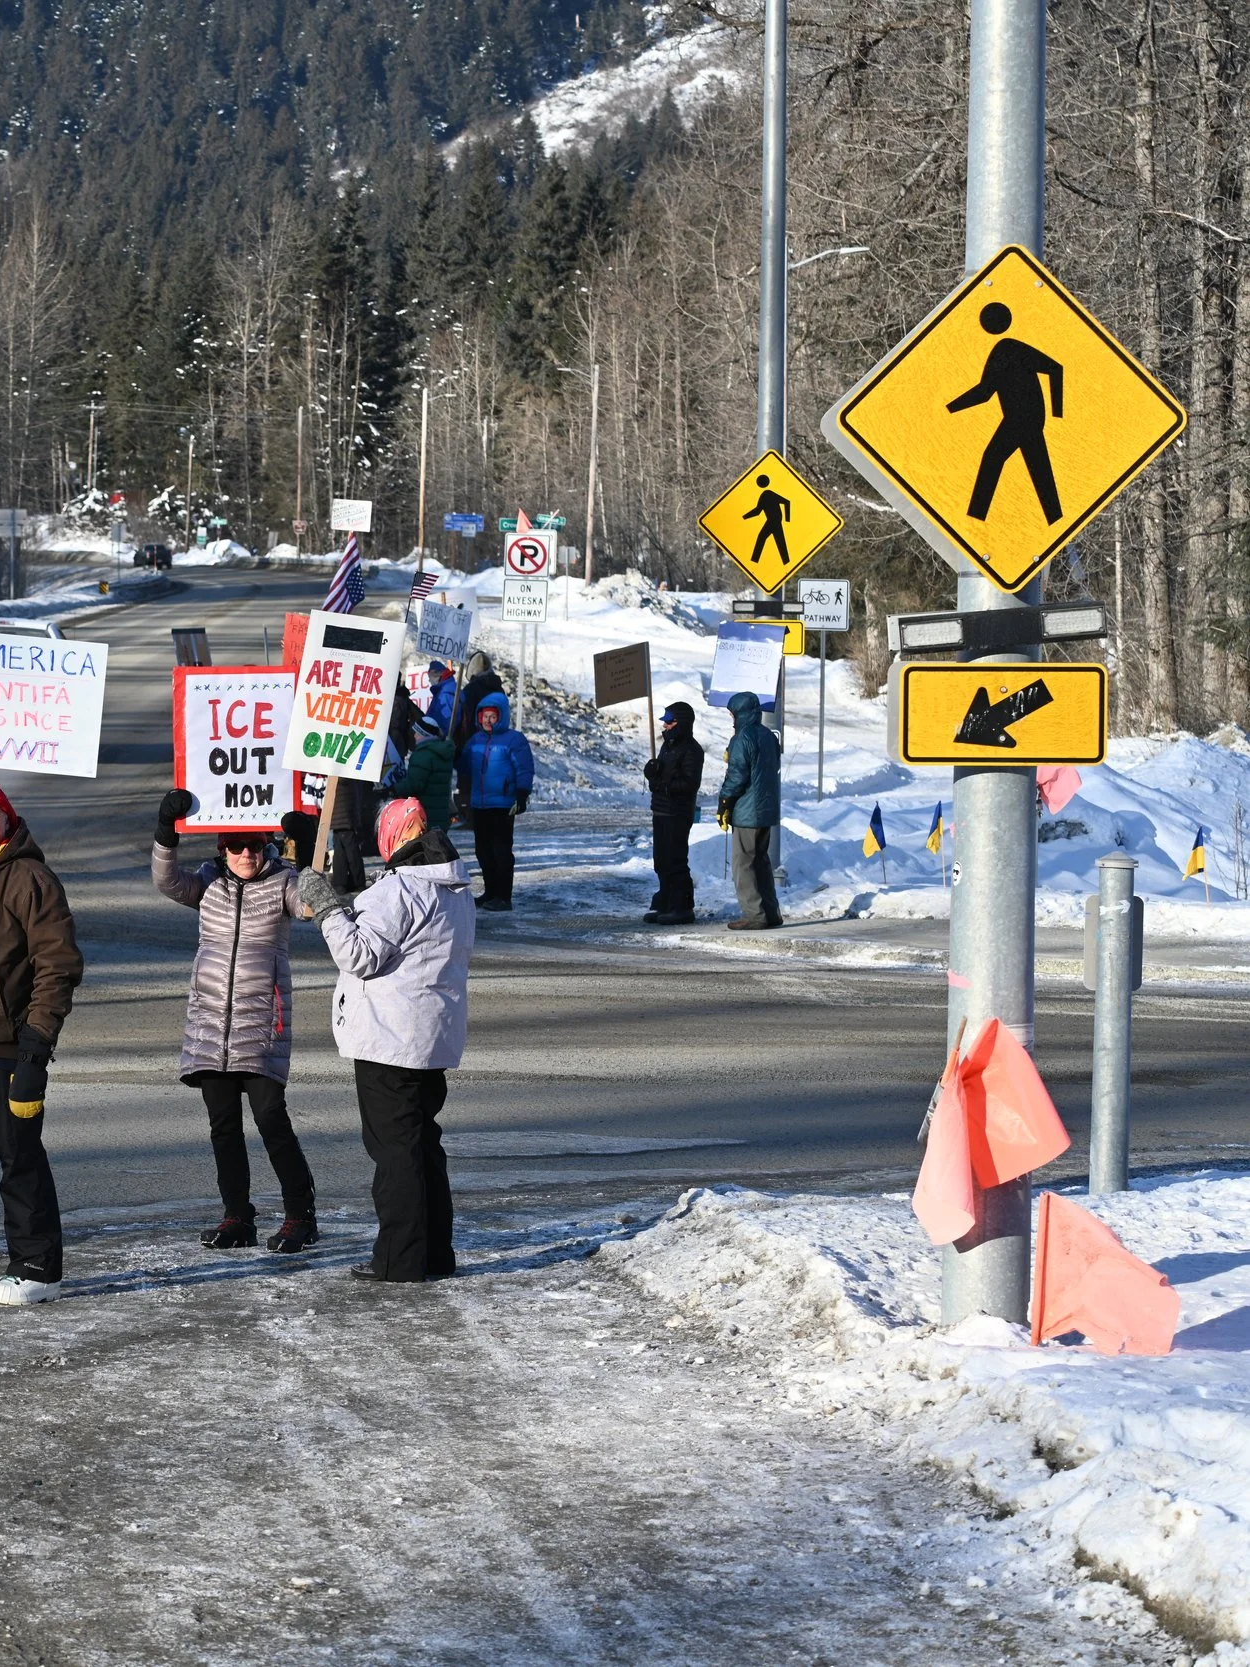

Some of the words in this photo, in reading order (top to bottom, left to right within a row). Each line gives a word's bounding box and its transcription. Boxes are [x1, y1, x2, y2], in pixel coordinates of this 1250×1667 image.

[507, 596, 543, 606] ALYESKA
[520, 584, 532, 593] ON
[506, 608, 542, 617] HIGHWAY
[804, 614, 842, 623] PATHWAY
[419, 632, 467, 660] FREEDOM
[305, 660, 343, 688] ARE
[351, 664, 383, 695] FOR
[208, 699, 275, 740] ICE
[306, 690, 383, 730] VICTIMS
[208, 746, 275, 776] OUT
[302, 730, 375, 771] ONLY!
[225, 782, 274, 808] NOW
